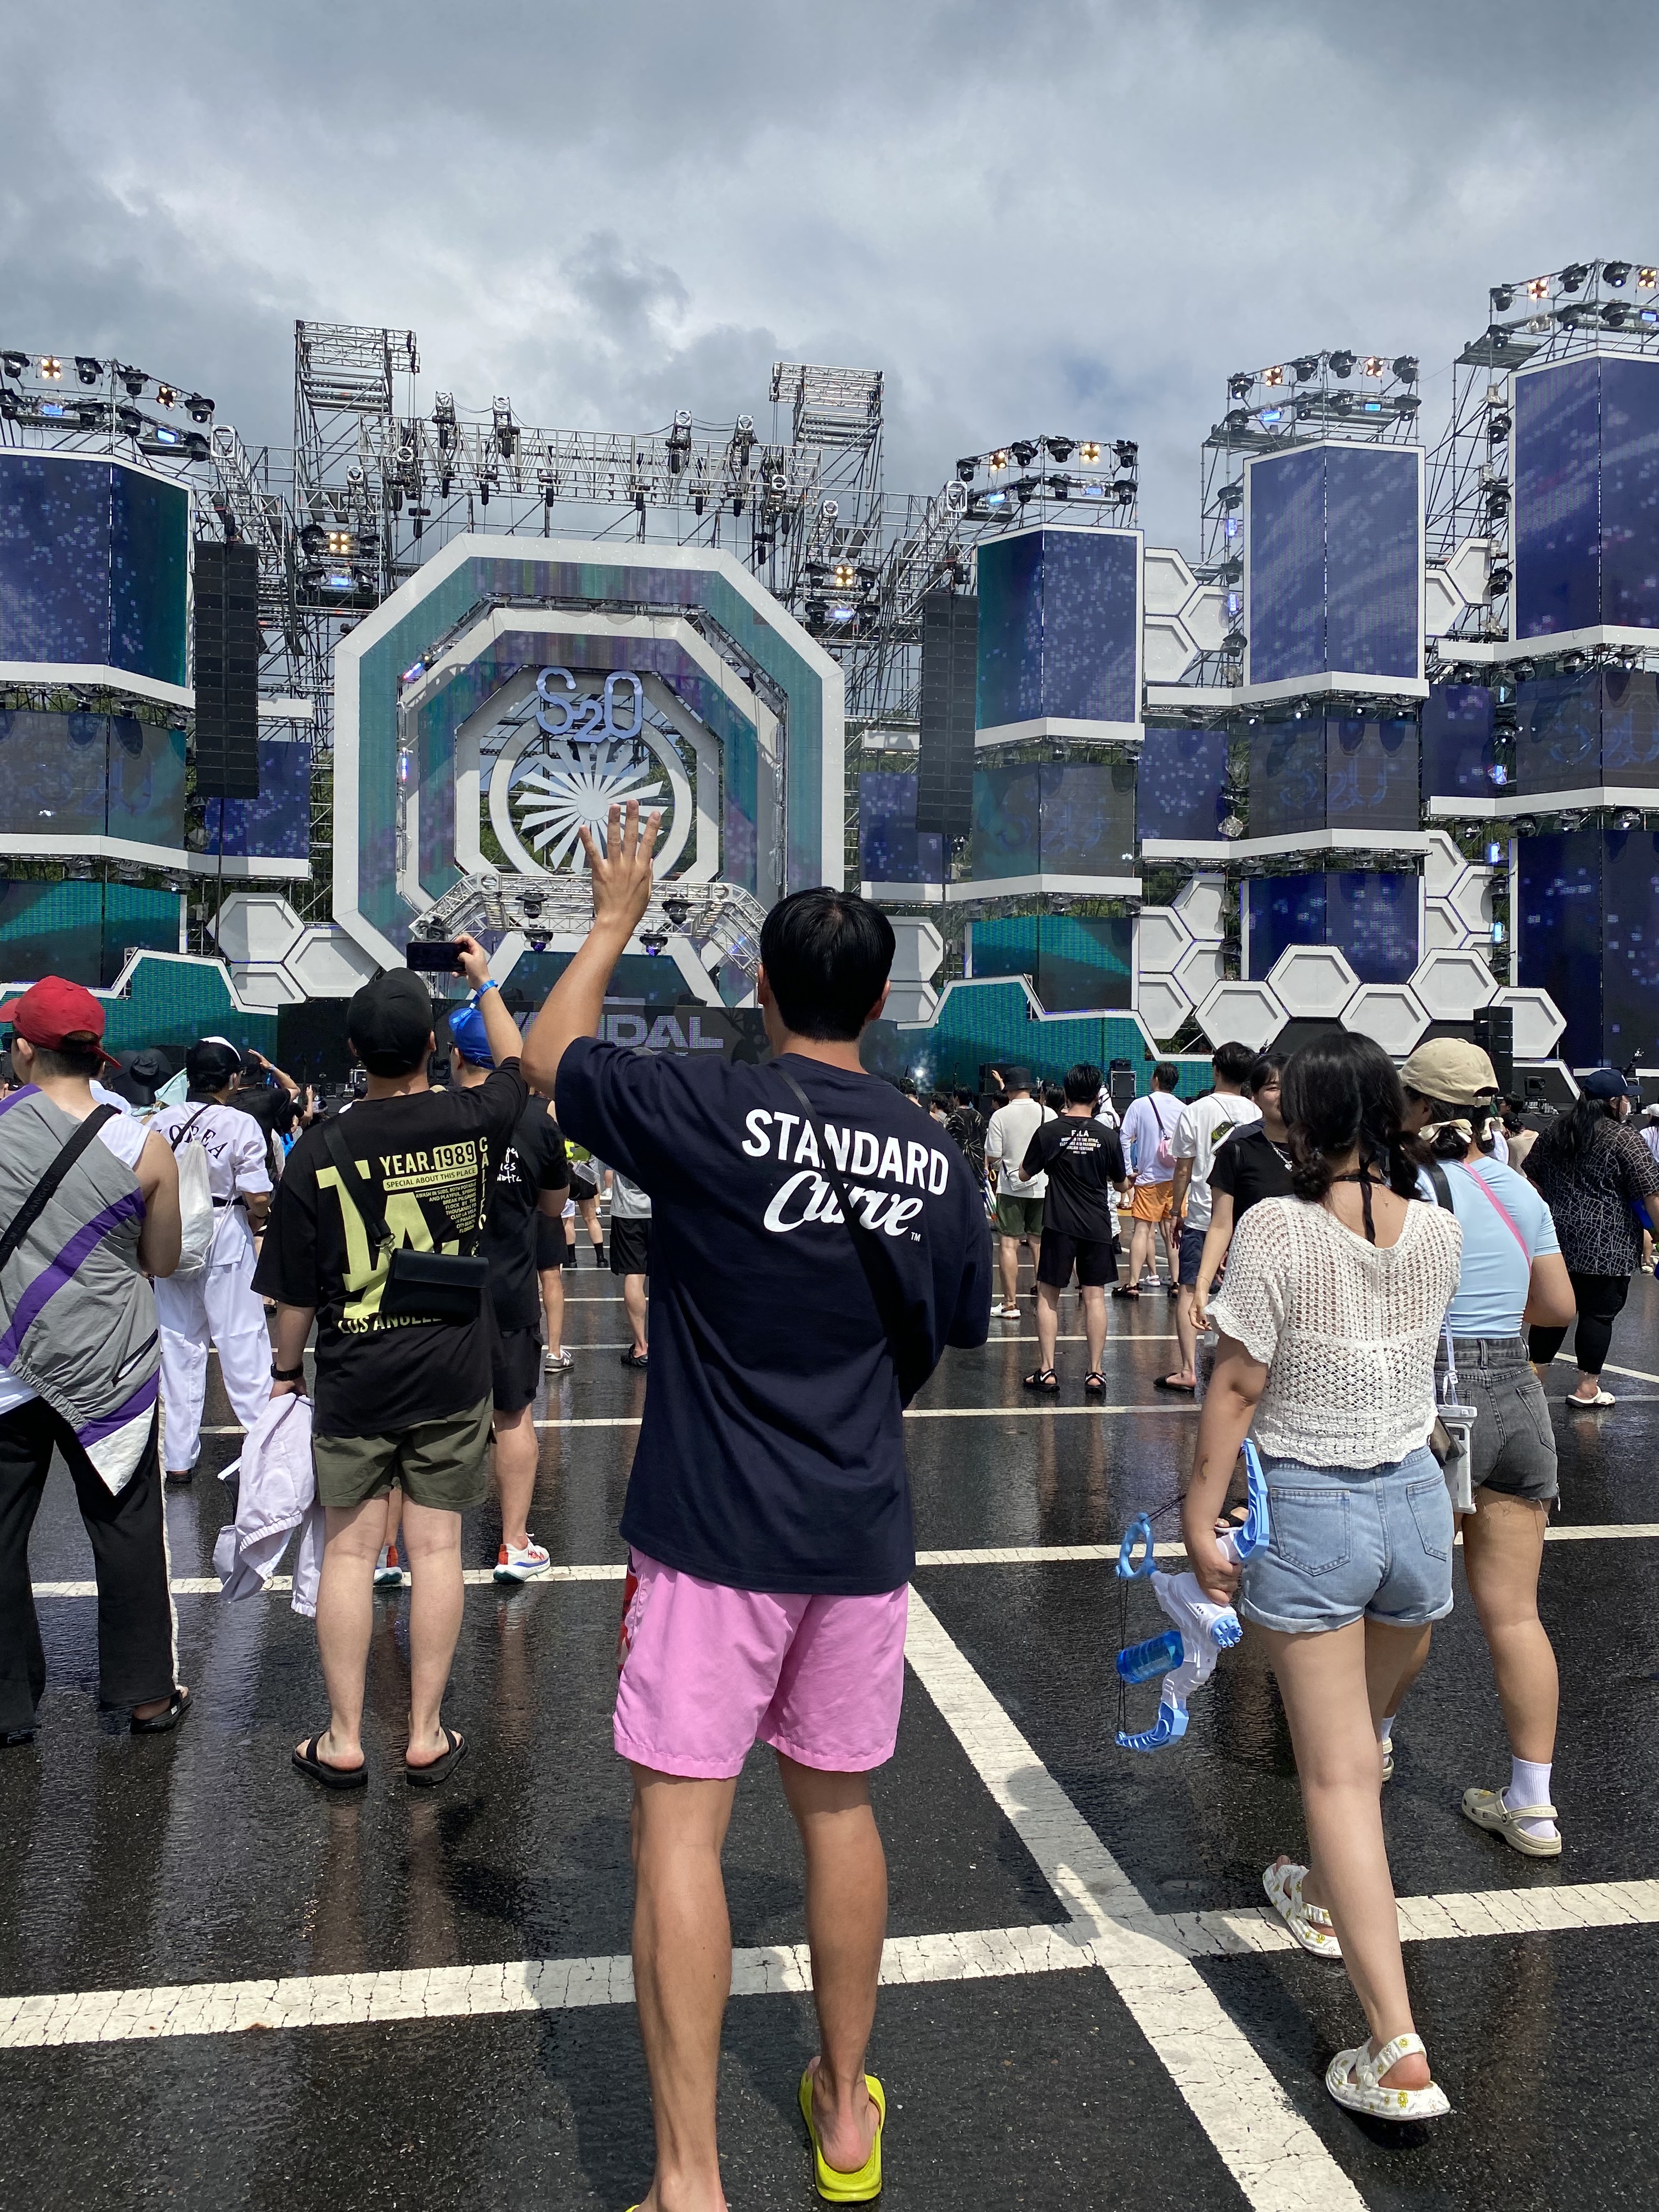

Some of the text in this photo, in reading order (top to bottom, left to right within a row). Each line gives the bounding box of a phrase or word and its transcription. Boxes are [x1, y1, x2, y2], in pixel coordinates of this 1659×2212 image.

[156, 1125, 228, 1159] OREA
[436, 1143, 475, 1168] 1989
[742, 1109, 949, 1195] STANDARD
[386, 1167, 476, 1188] SPECIAL ABOUT THIS PLACE
[443, 1197, 458, 1205] BREAK
[763, 1170, 923, 1242] Curve TM
